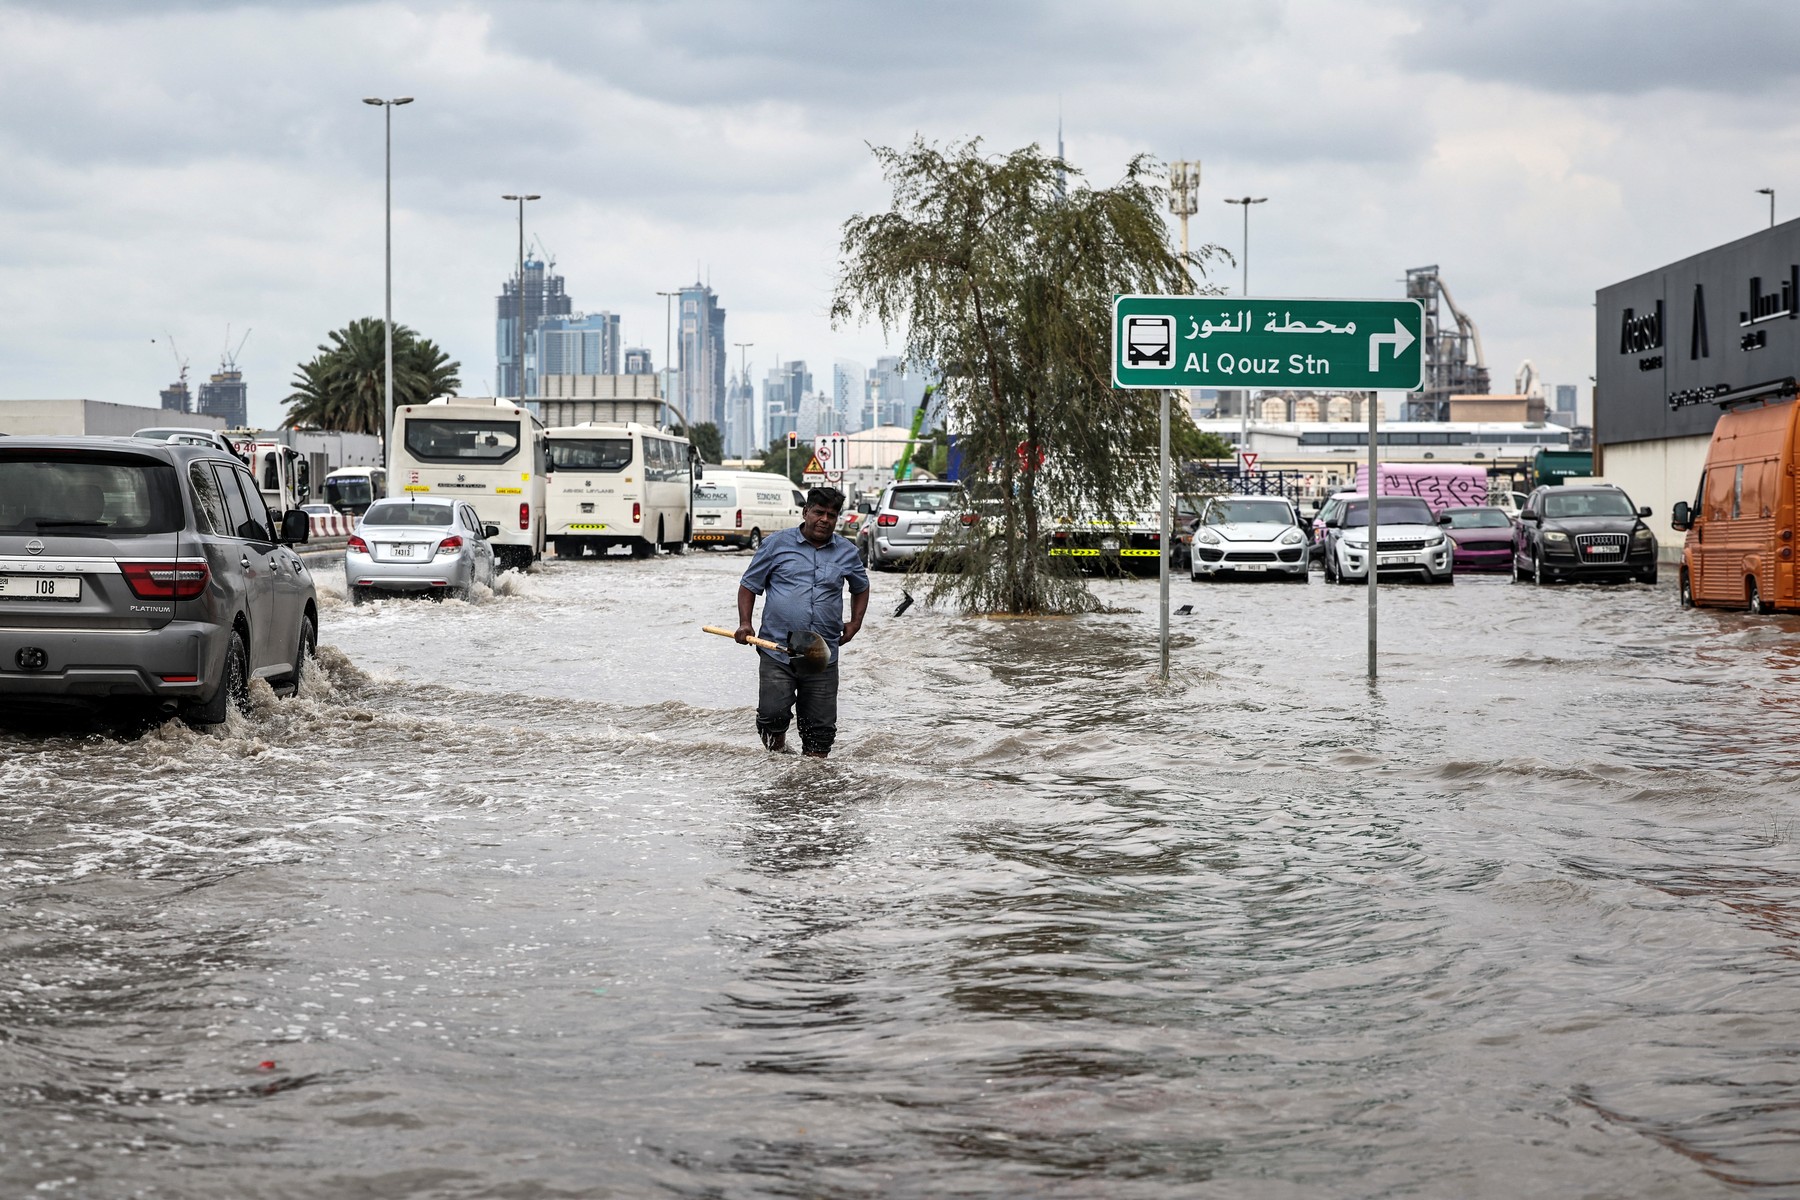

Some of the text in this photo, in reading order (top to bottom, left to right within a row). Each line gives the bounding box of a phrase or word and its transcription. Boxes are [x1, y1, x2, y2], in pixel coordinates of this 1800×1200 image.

[1184, 309, 1357, 340] محطة القوز
[1184, 352, 1330, 375] Al Qouz Stn
[35, 580, 55, 594] 108
[130, 605, 171, 613] PLATINUM
